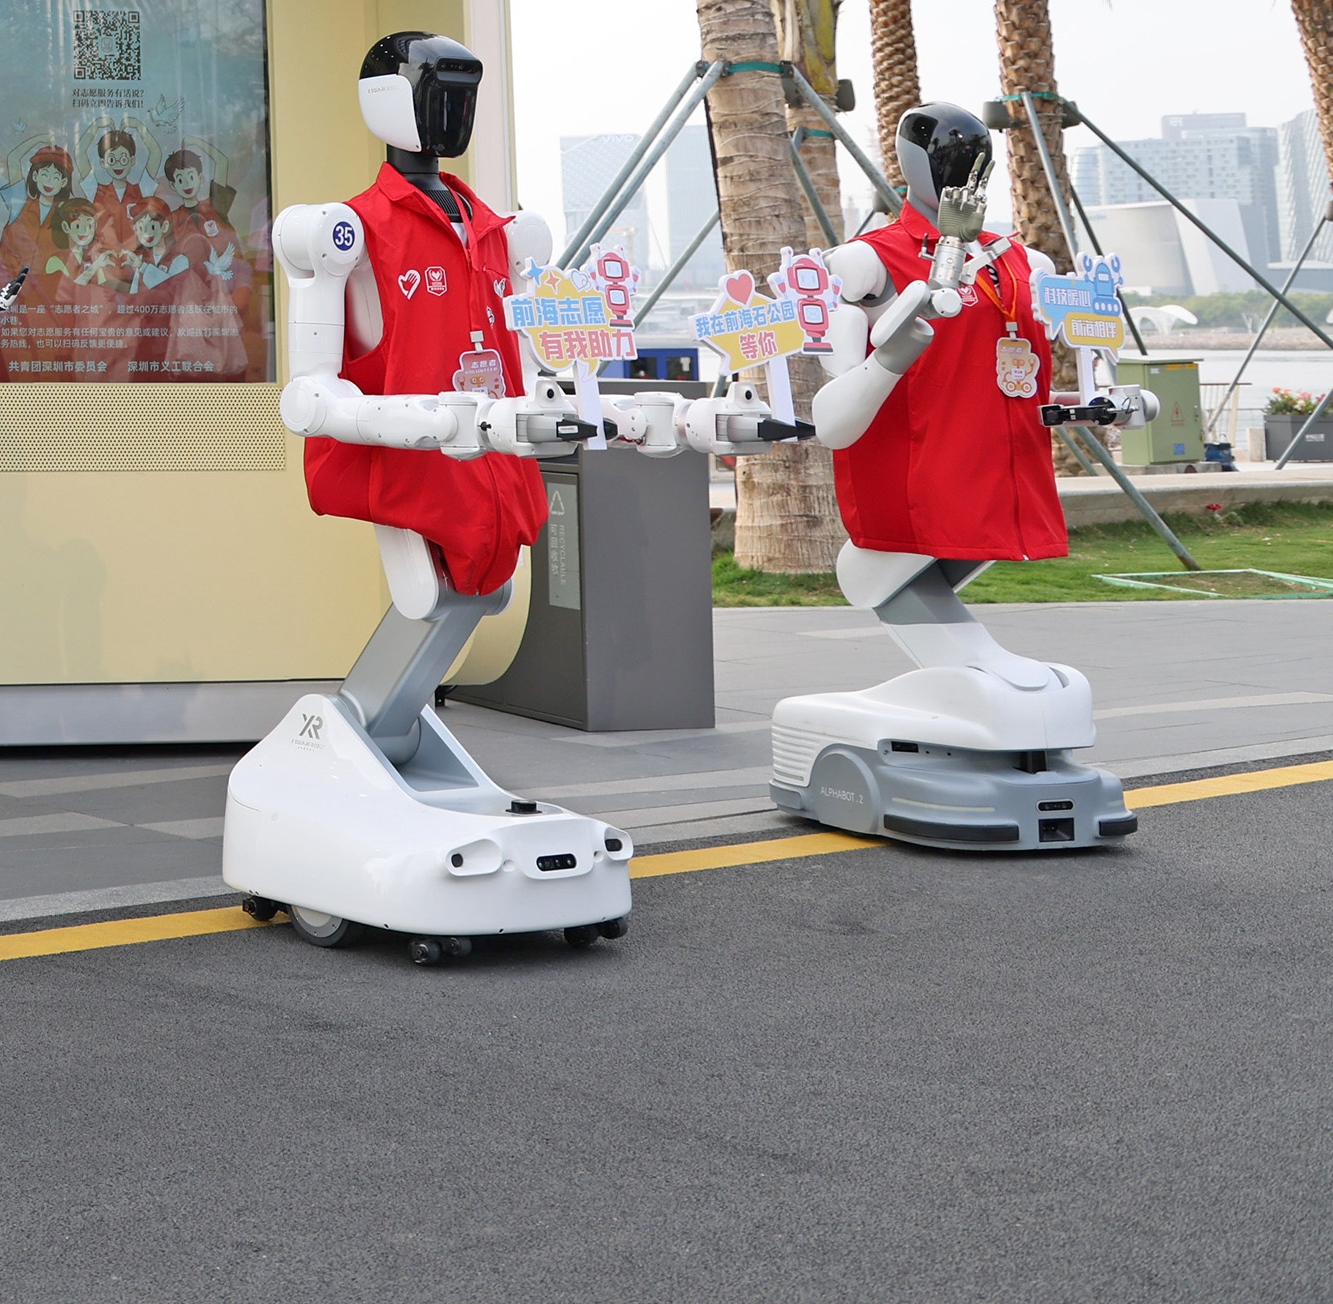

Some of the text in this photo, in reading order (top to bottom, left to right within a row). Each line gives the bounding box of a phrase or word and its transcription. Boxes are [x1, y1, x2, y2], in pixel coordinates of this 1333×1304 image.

[335, 225, 353, 247] 35
[1044, 287, 1091, 308] 科技暖心
[511, 296, 607, 327] 前海志愿
[695, 300, 796, 338] 我在前海石公园
[1071, 319, 1117, 339] 前海相伴
[539, 329, 636, 360] 有我助力
[740, 331, 778, 359] 等你
[9, 360, 215, 373] 共青团深圳市委员会 深圳市义工联合会
